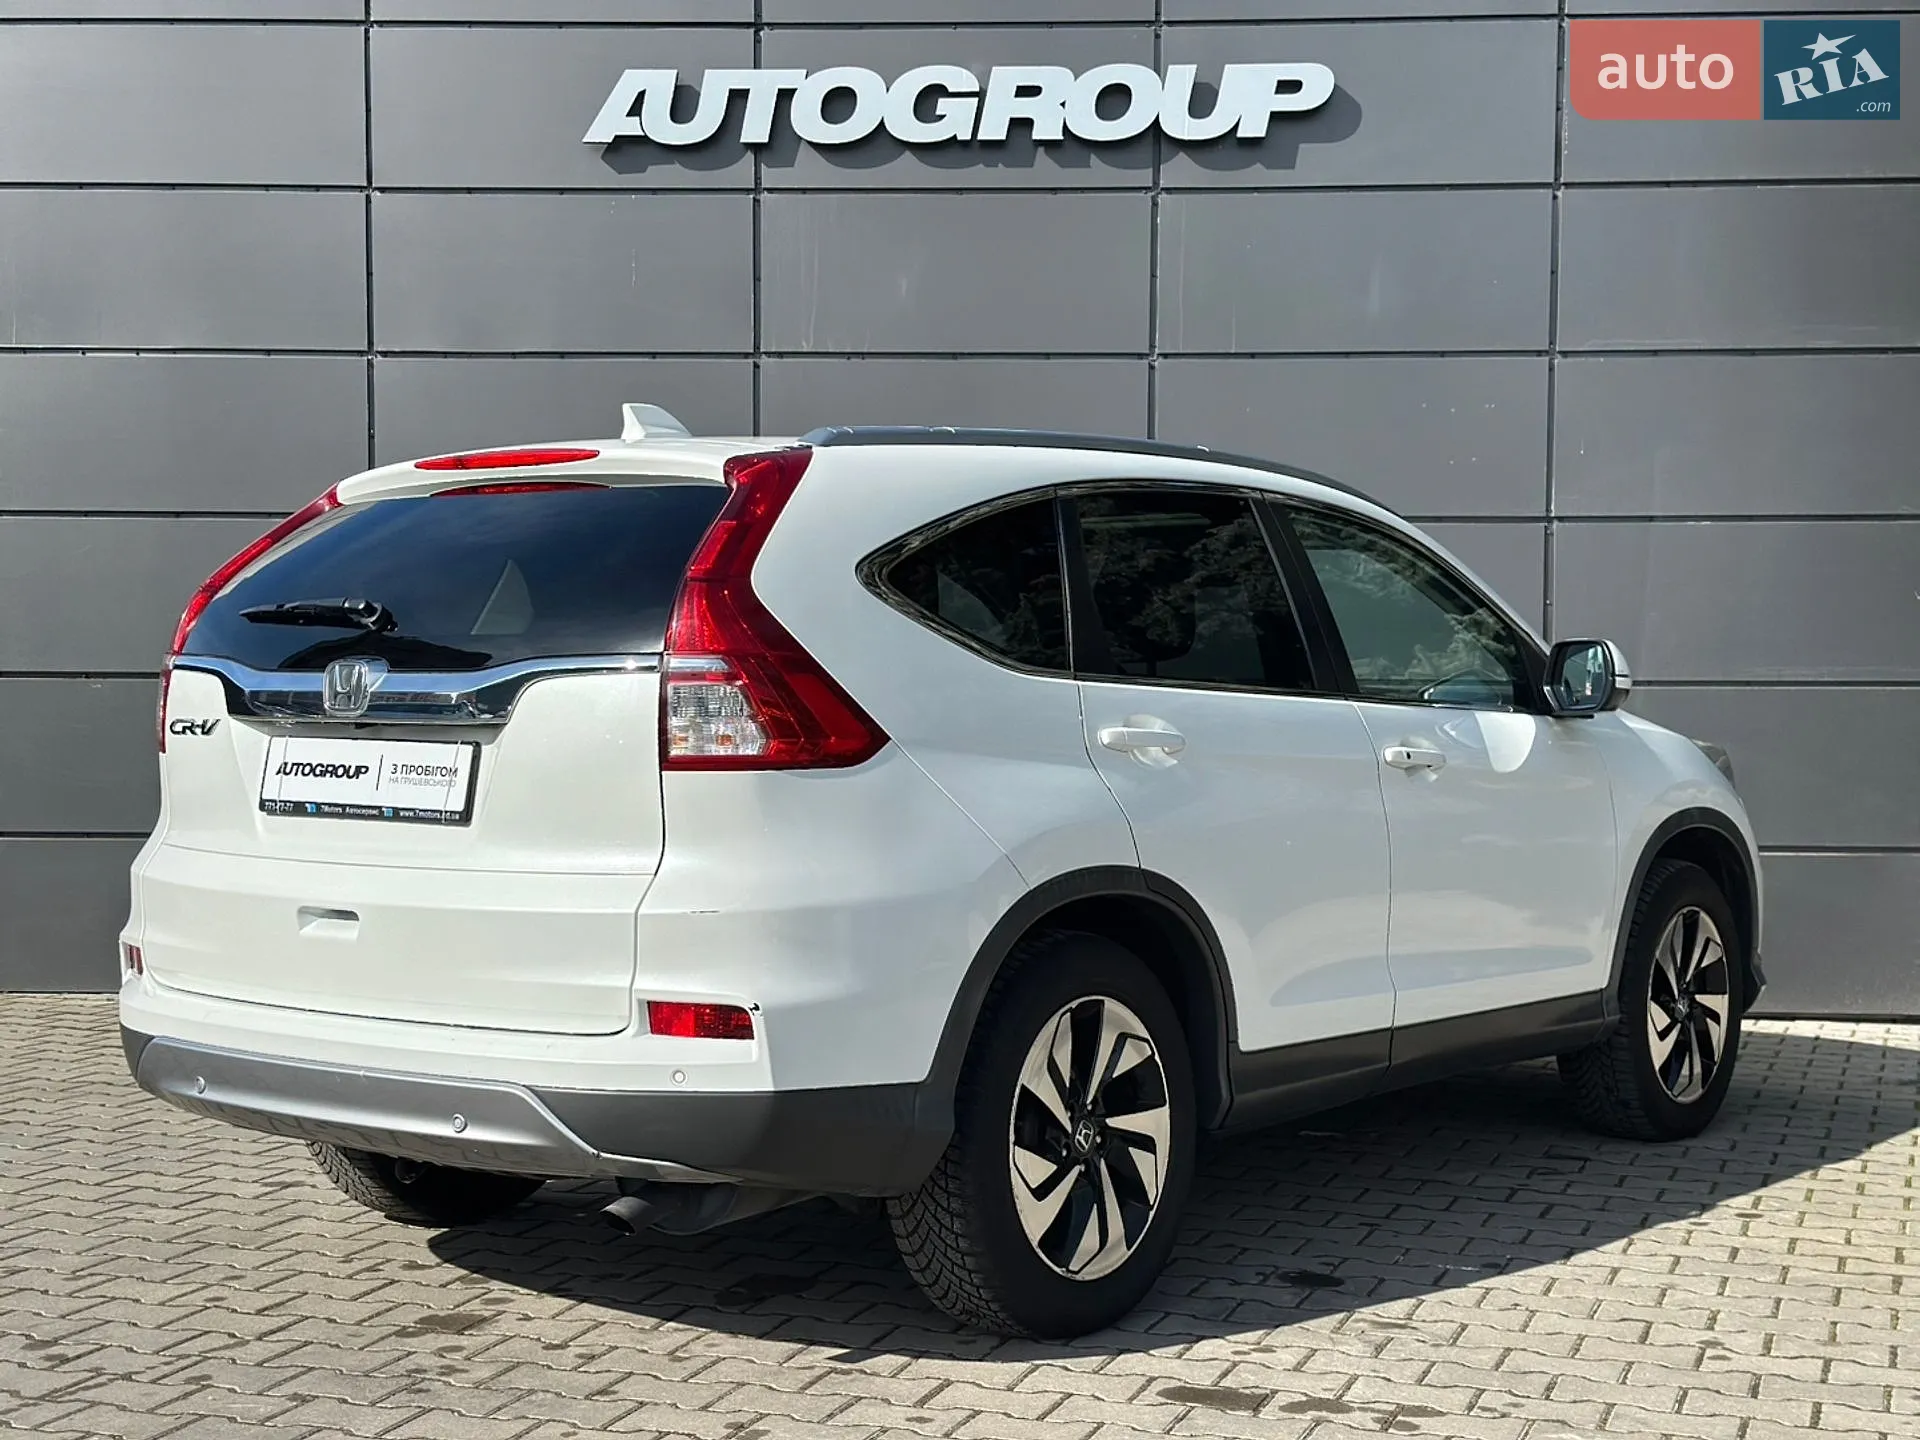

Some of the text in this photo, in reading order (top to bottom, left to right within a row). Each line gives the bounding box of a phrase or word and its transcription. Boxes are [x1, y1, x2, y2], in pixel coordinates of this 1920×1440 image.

[583, 62, 1336, 146] AUTOGROUP
[169, 718, 221, 736] CR-V
[275, 761, 370, 780] AUTOGROUP
[400, 763, 459, 778] ПРОБІГОМ
